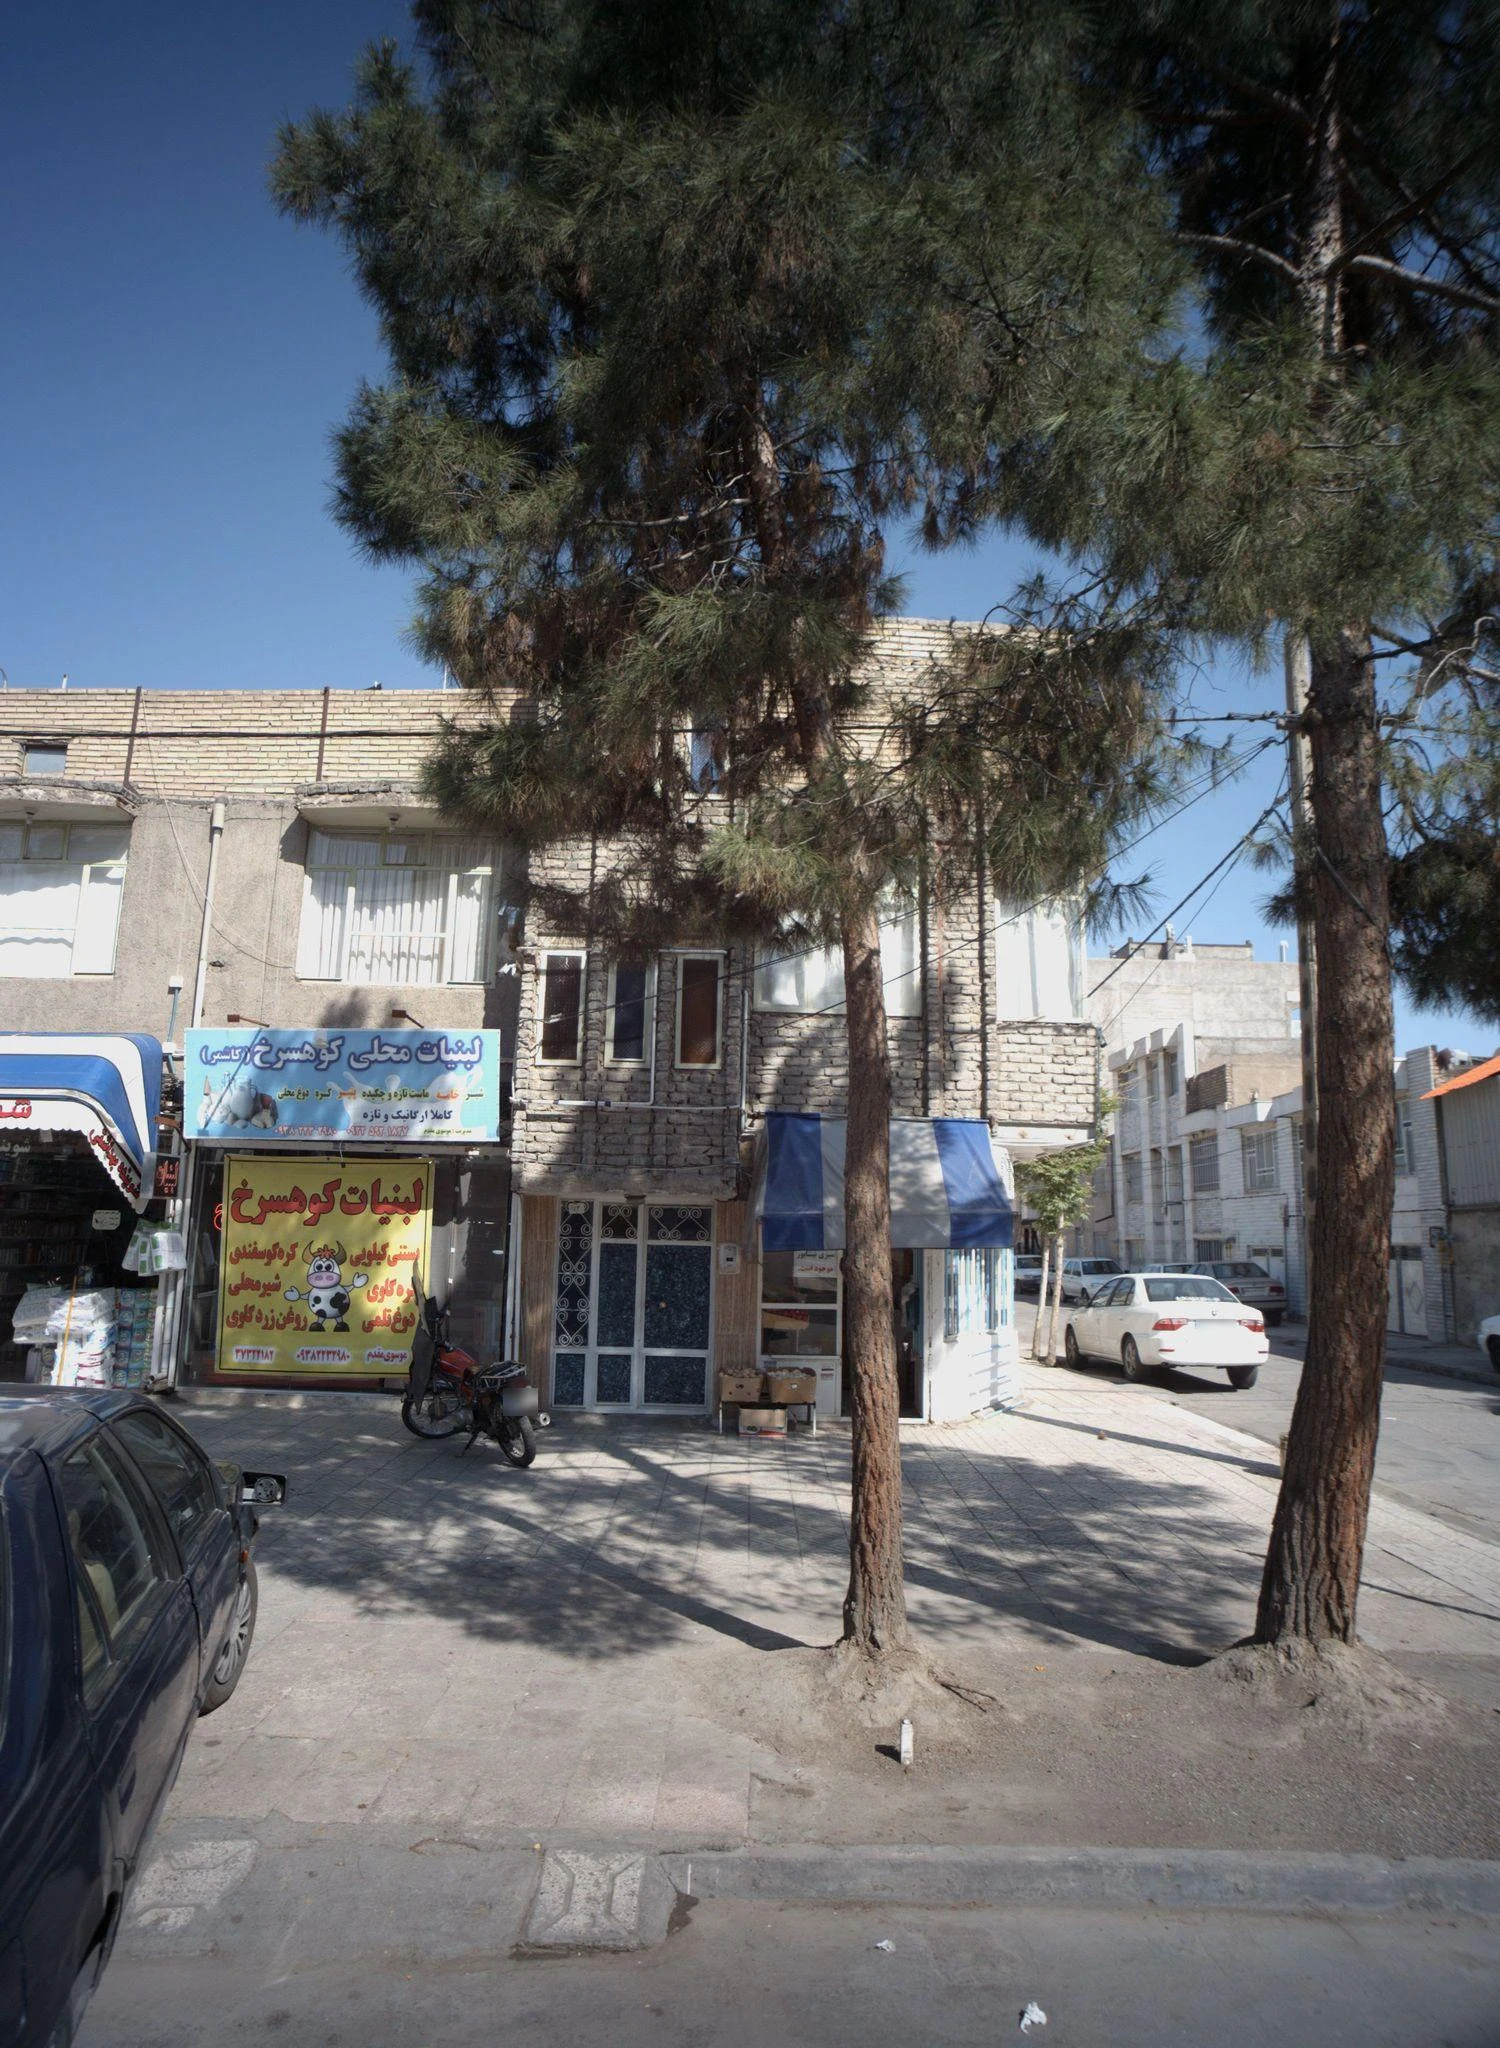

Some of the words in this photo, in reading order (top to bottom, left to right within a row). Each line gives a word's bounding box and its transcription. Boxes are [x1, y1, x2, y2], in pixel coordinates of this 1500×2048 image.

[251, 1036, 345, 1071] کوهسرخ
[348, 1035, 412, 1070] محلی
[415, 1035, 483, 1071] لبنیات
[436, 1088, 459, 1100] خامه
[362, 1109, 381, 1122] تازه
[383, 1113, 389, 1122] و
[430, 1109, 454, 1121] کاملا
[231, 1178, 342, 1228] کوهسرخ
[340, 1178, 424, 1226] لبنیات
[229, 1241, 280, 1267] گوسفندی
[277, 1242, 299, 1267] کره
[228, 1271, 262, 1297] محلی
[259, 1273, 282, 1298] شیر
[366, 1278, 397, 1303] گاوی
[396, 1284, 414, 1304] ره
[226, 1303, 255, 1329] گاوی
[255, 1308, 276, 1331] زرد
[275, 1305, 308, 1331] روغن
[390, 1306, 416, 1335] دوغ
